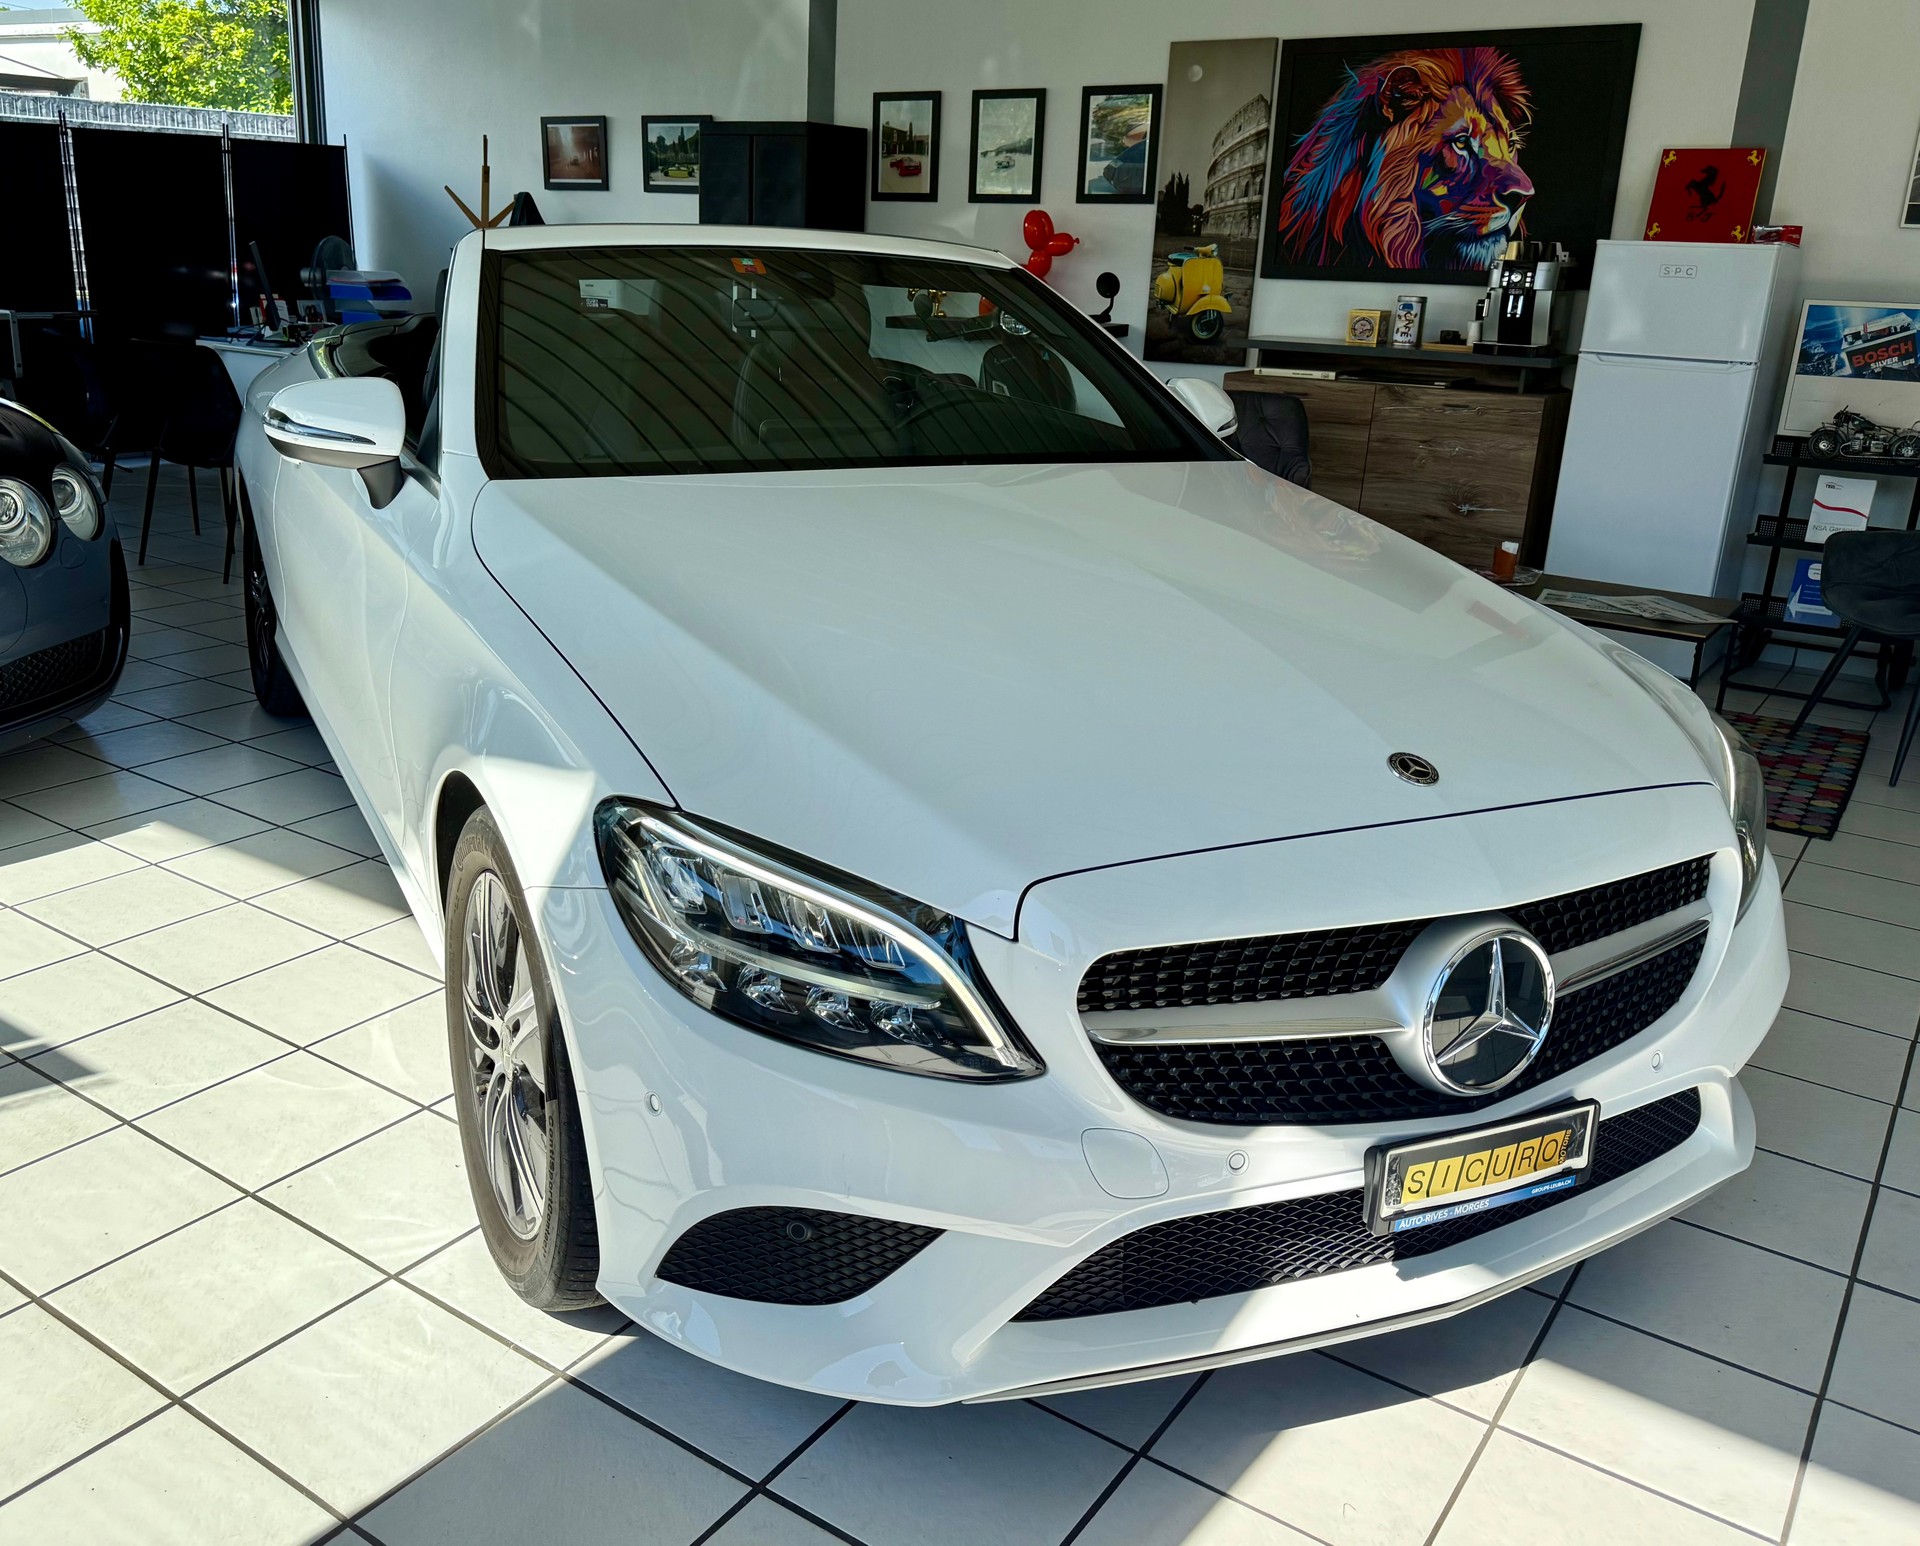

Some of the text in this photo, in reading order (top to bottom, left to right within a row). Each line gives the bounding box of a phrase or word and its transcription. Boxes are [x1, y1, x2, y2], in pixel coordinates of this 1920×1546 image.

[1851, 339, 1914, 368] BOSCH
[1870, 356, 1899, 369] SILVER
[1812, 524, 1828, 532] NSA
[1558, 1129, 1572, 1165] MOTORS
[1407, 1138, 1559, 1194] SICURO
[1531, 1179, 1572, 1194] GROUPE-LEUBA.CH
[1399, 1207, 1448, 1229] AUTO-RIVES
[1454, 1199, 1490, 1216] MORGES
